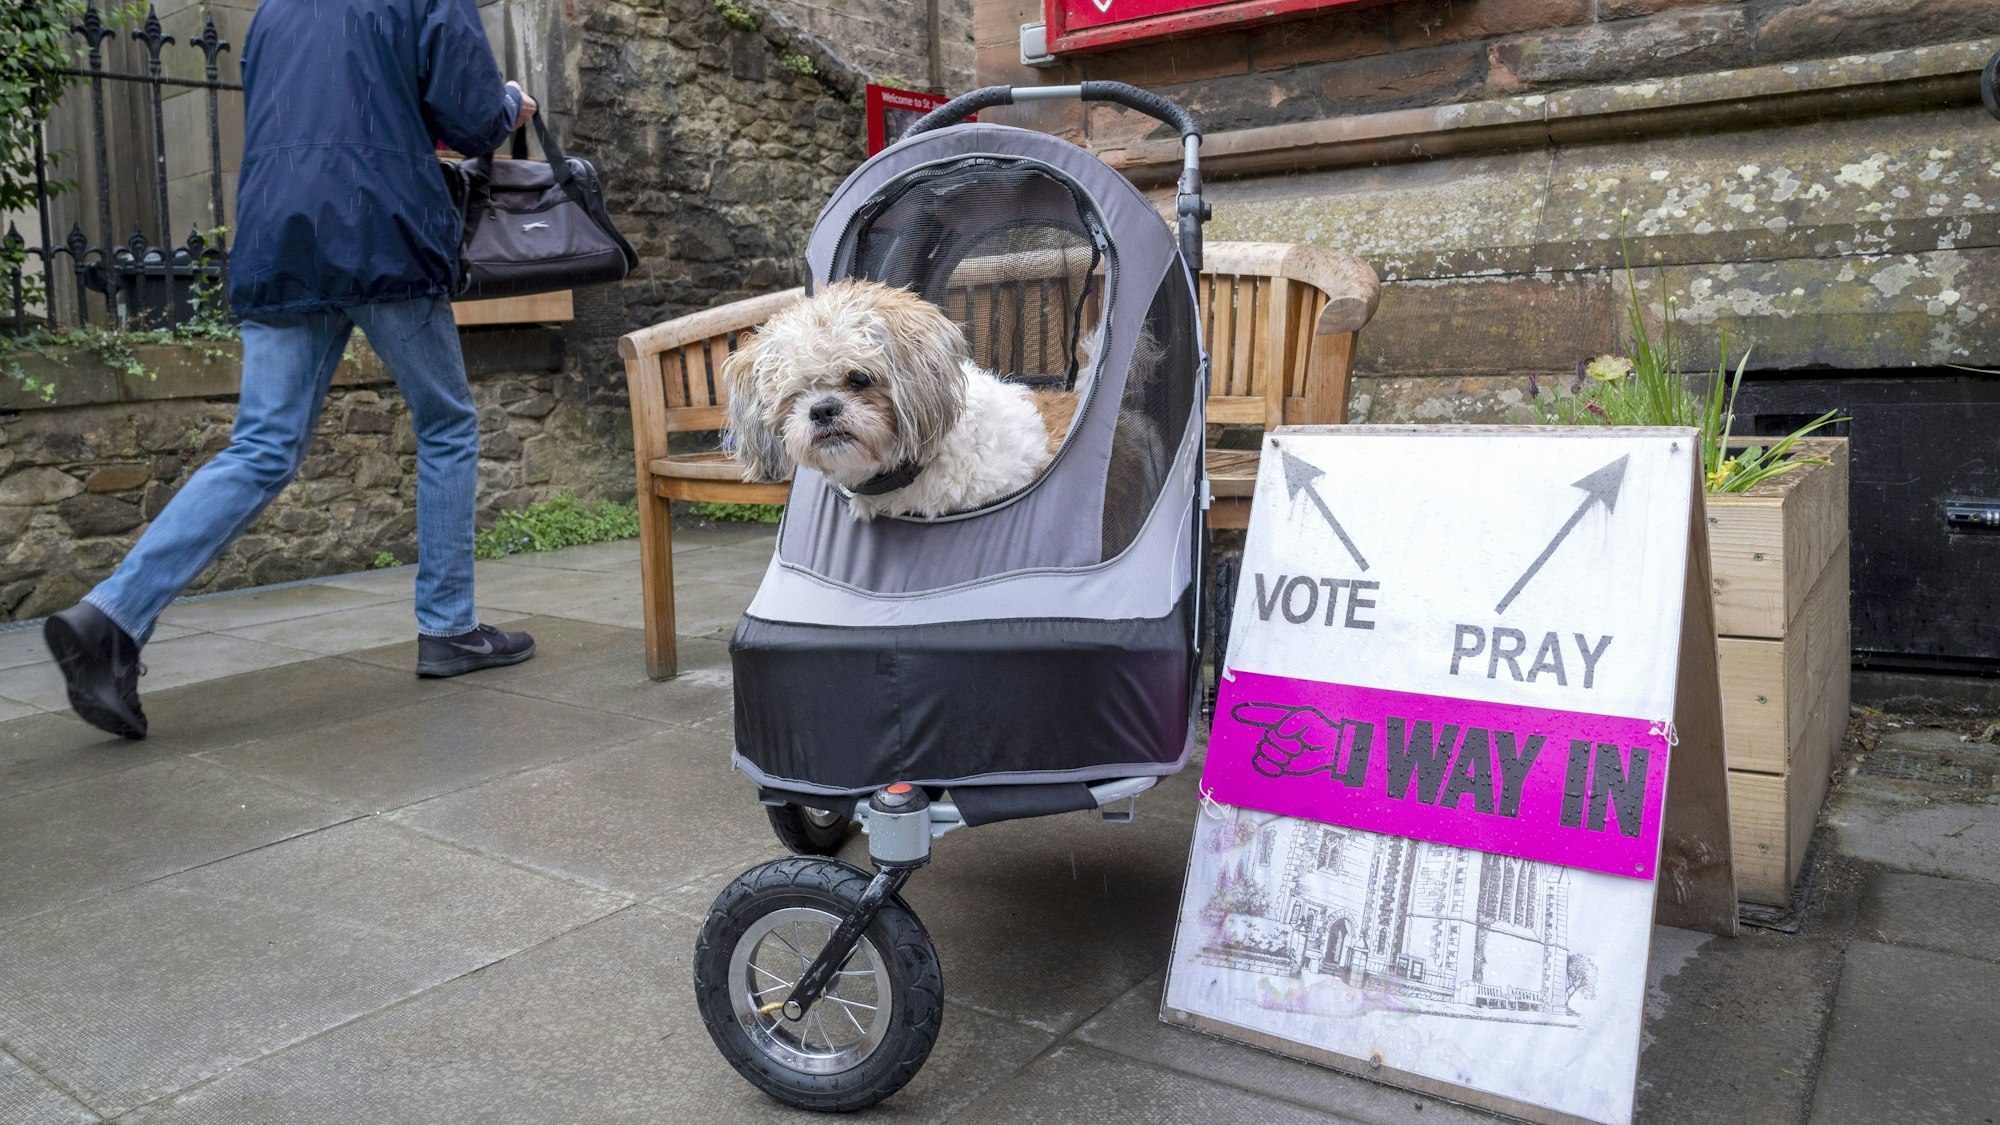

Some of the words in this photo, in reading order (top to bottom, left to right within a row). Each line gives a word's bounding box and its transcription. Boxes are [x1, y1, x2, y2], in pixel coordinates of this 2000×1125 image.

[881, 91, 913, 106] Welcome
[914, 98, 922, 108] to
[1255, 573, 1380, 630] VOTE
[1450, 624, 1614, 689] PRAY
[1386, 716, 1548, 819] WAY
[1559, 739, 1650, 838] IN
